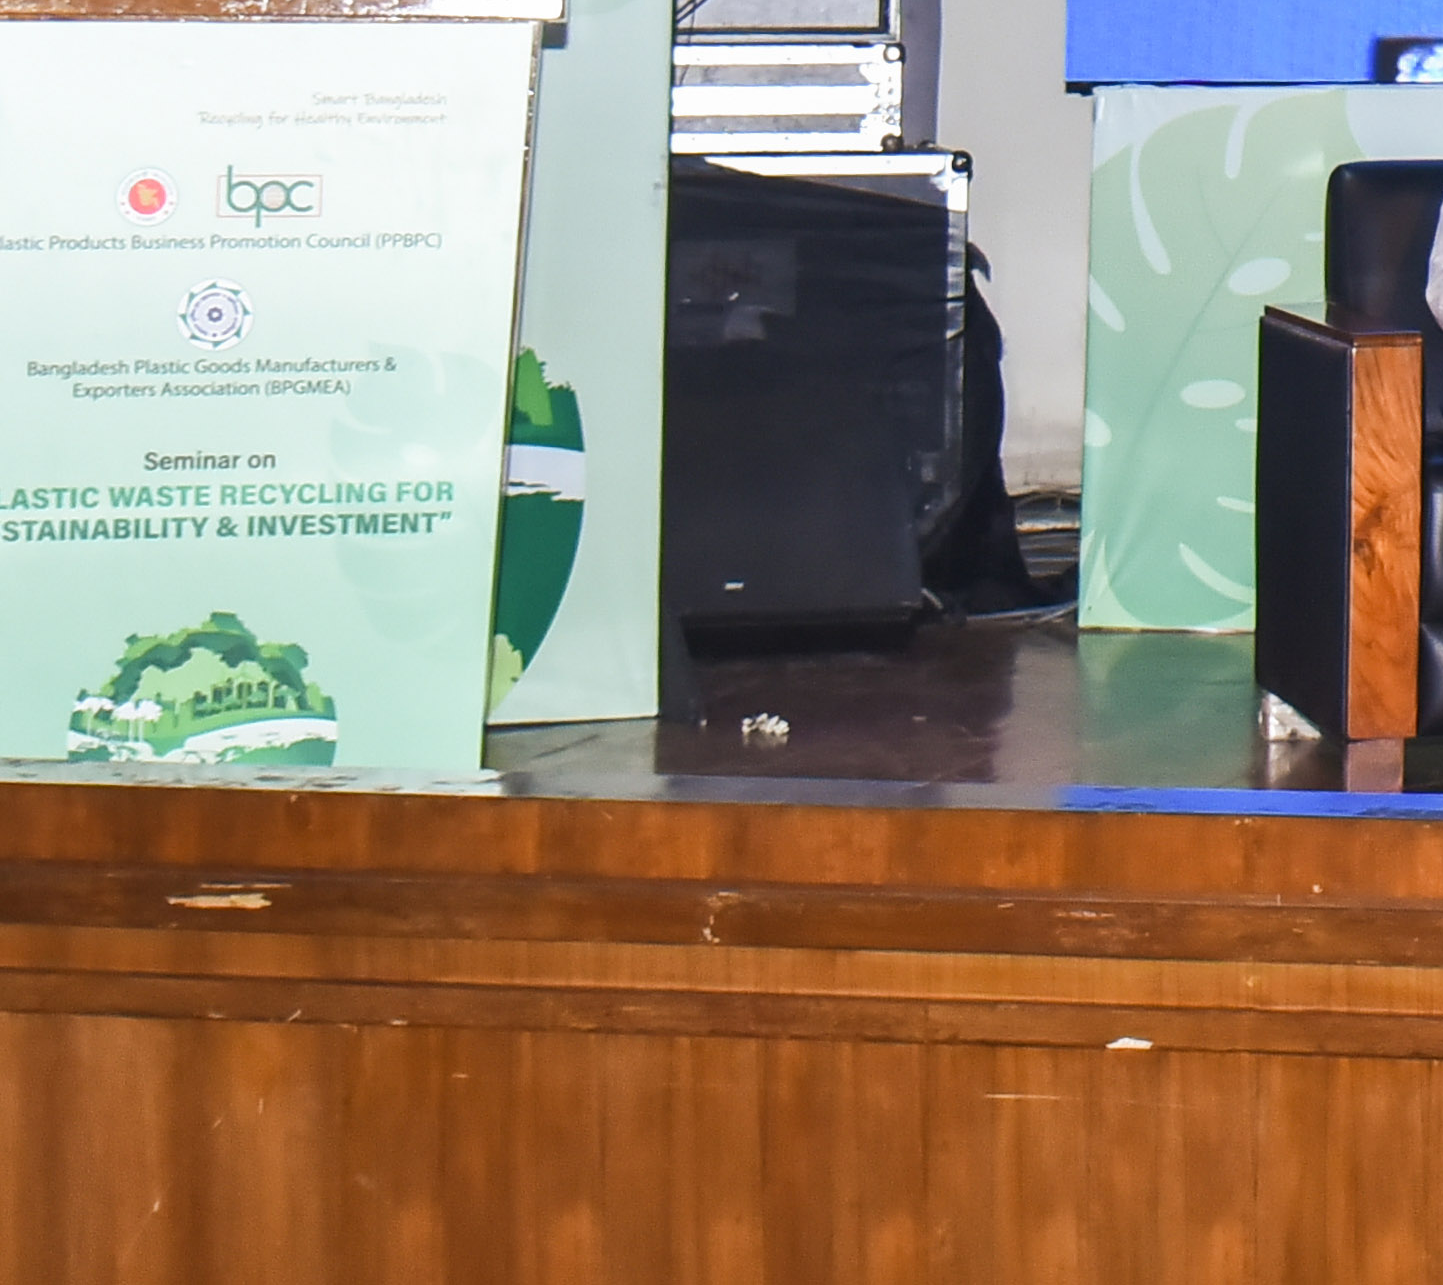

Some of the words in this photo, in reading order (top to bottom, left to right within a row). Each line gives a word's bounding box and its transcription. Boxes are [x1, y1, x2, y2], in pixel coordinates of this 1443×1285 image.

[49, 236, 126, 250] Products
[131, 235, 205, 250] Business
[210, 234, 301, 249] Promotion
[306, 234, 370, 248] Council
[376, 233, 442, 249] (PPBPC)
[27, 361, 129, 380] Bangladesh
[134, 360, 189, 375] Plastic
[194, 359, 251, 374] Goods
[255, 358, 380, 373] Manufacturers
[384, 357, 396, 371] &
[73, 383, 156, 401] Exporters
[161, 382, 260, 396] Association
[265, 380, 351, 396] (BPGMEA)
[144, 451, 240, 471] Seminar
[248, 455, 275, 469] on
[109, 486, 210, 508] WASTE
[221, 483, 387, 505] RECYCLING
[396, 482, 453, 503] FOR
[3, 517, 208, 542] STAINABILITY
[216, 517, 238, 537] &
[248, 512, 451, 536] INVESTMENT”
